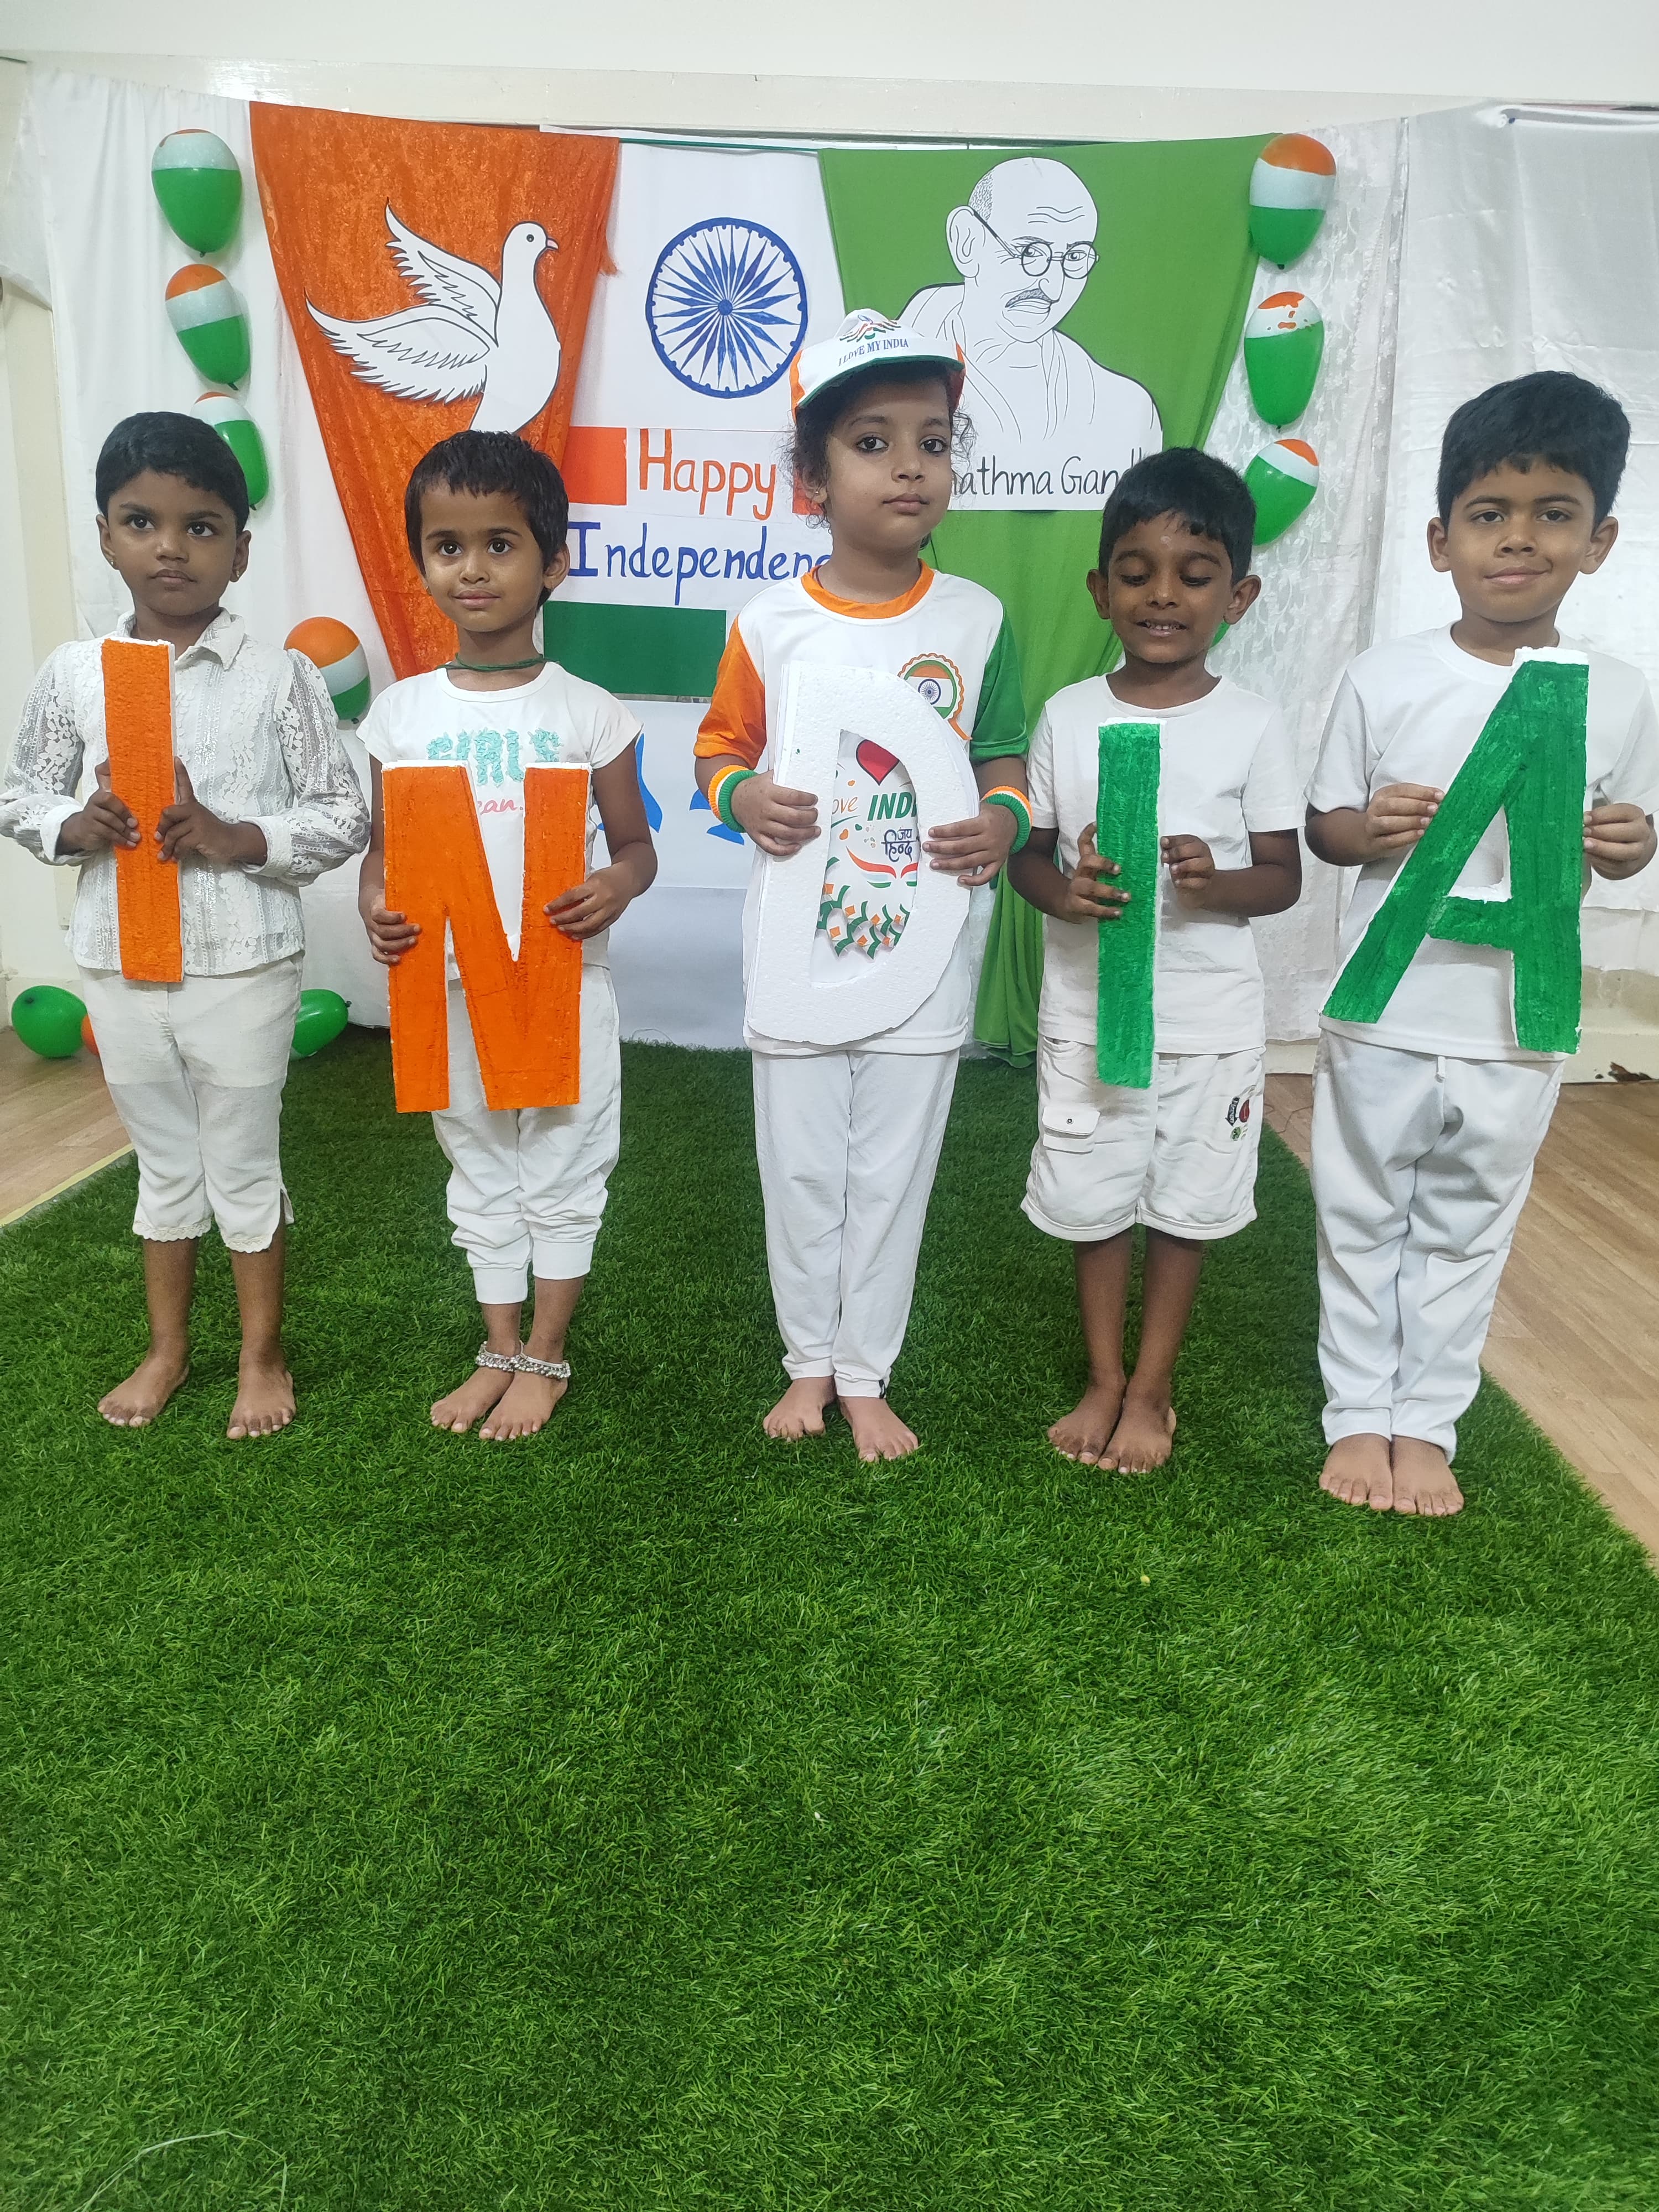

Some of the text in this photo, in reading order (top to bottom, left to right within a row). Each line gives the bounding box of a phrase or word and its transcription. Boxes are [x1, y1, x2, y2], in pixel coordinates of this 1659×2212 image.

[843, 345, 865, 363] LOVE
[867, 340, 881, 353] MY
[883, 338, 909, 349] INDIA
[639, 428, 776, 520] Happy
[1061, 447, 1142, 495] Gan
[832, 796, 858, 815] ove
[897, 828, 912, 841] जय
